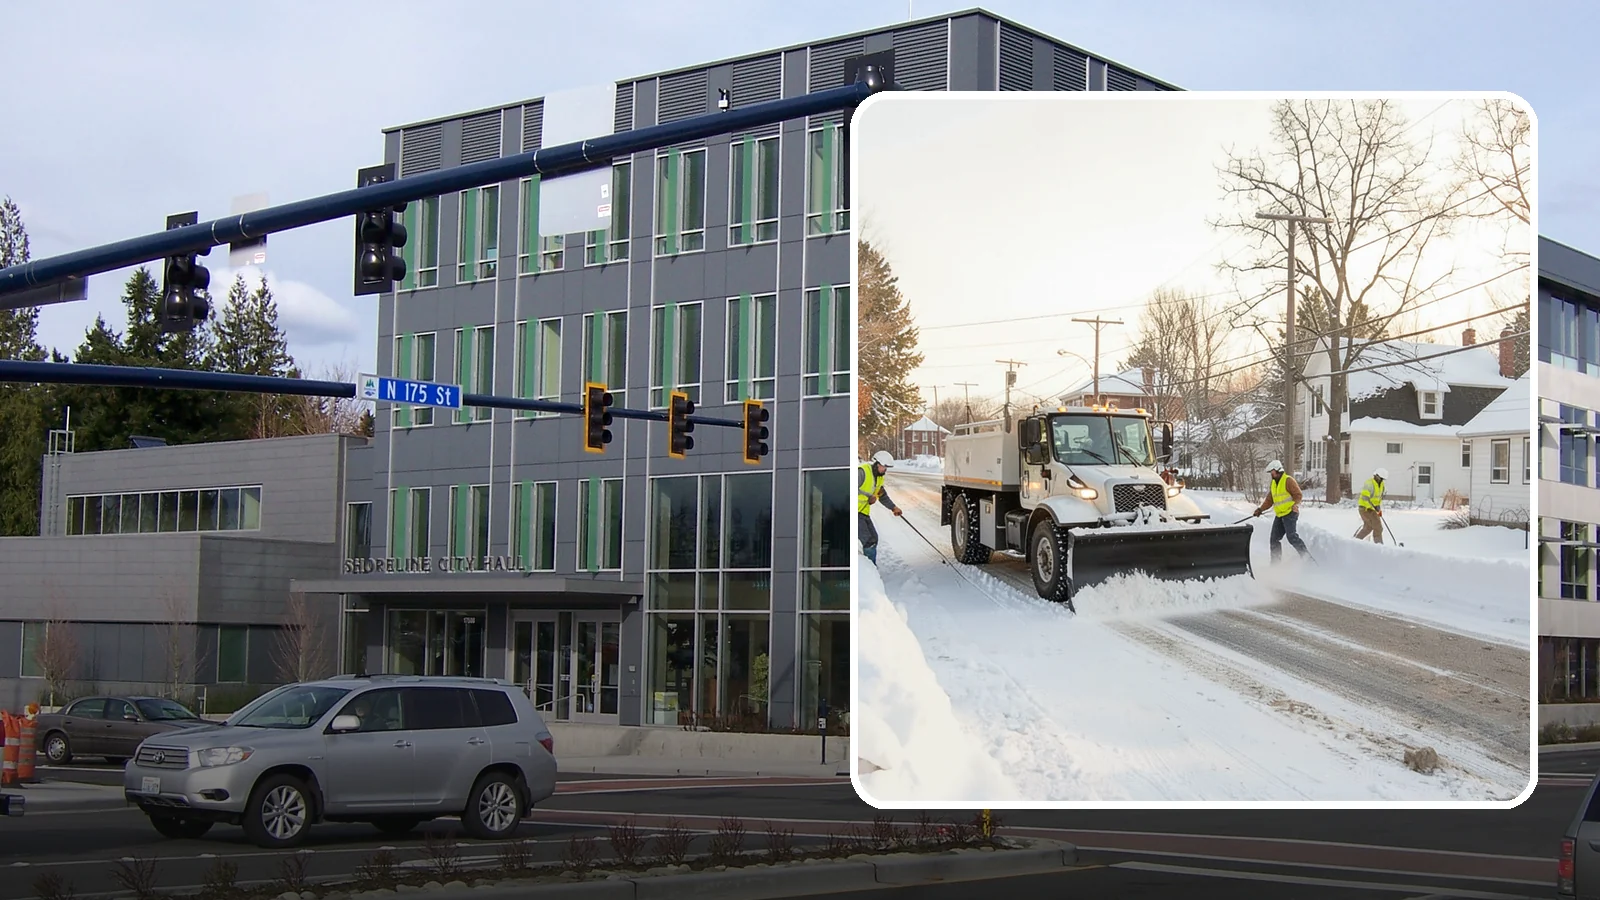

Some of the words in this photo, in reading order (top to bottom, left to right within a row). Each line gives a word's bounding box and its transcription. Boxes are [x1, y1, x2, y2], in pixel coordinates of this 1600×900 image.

[387, 380, 396, 400] N
[405, 382, 428, 403] 175
[436, 386, 451, 406] St
[344, 556, 432, 574] SHORELINE
[438, 556, 475, 572] CITY
[484, 555, 525, 572] HALL
